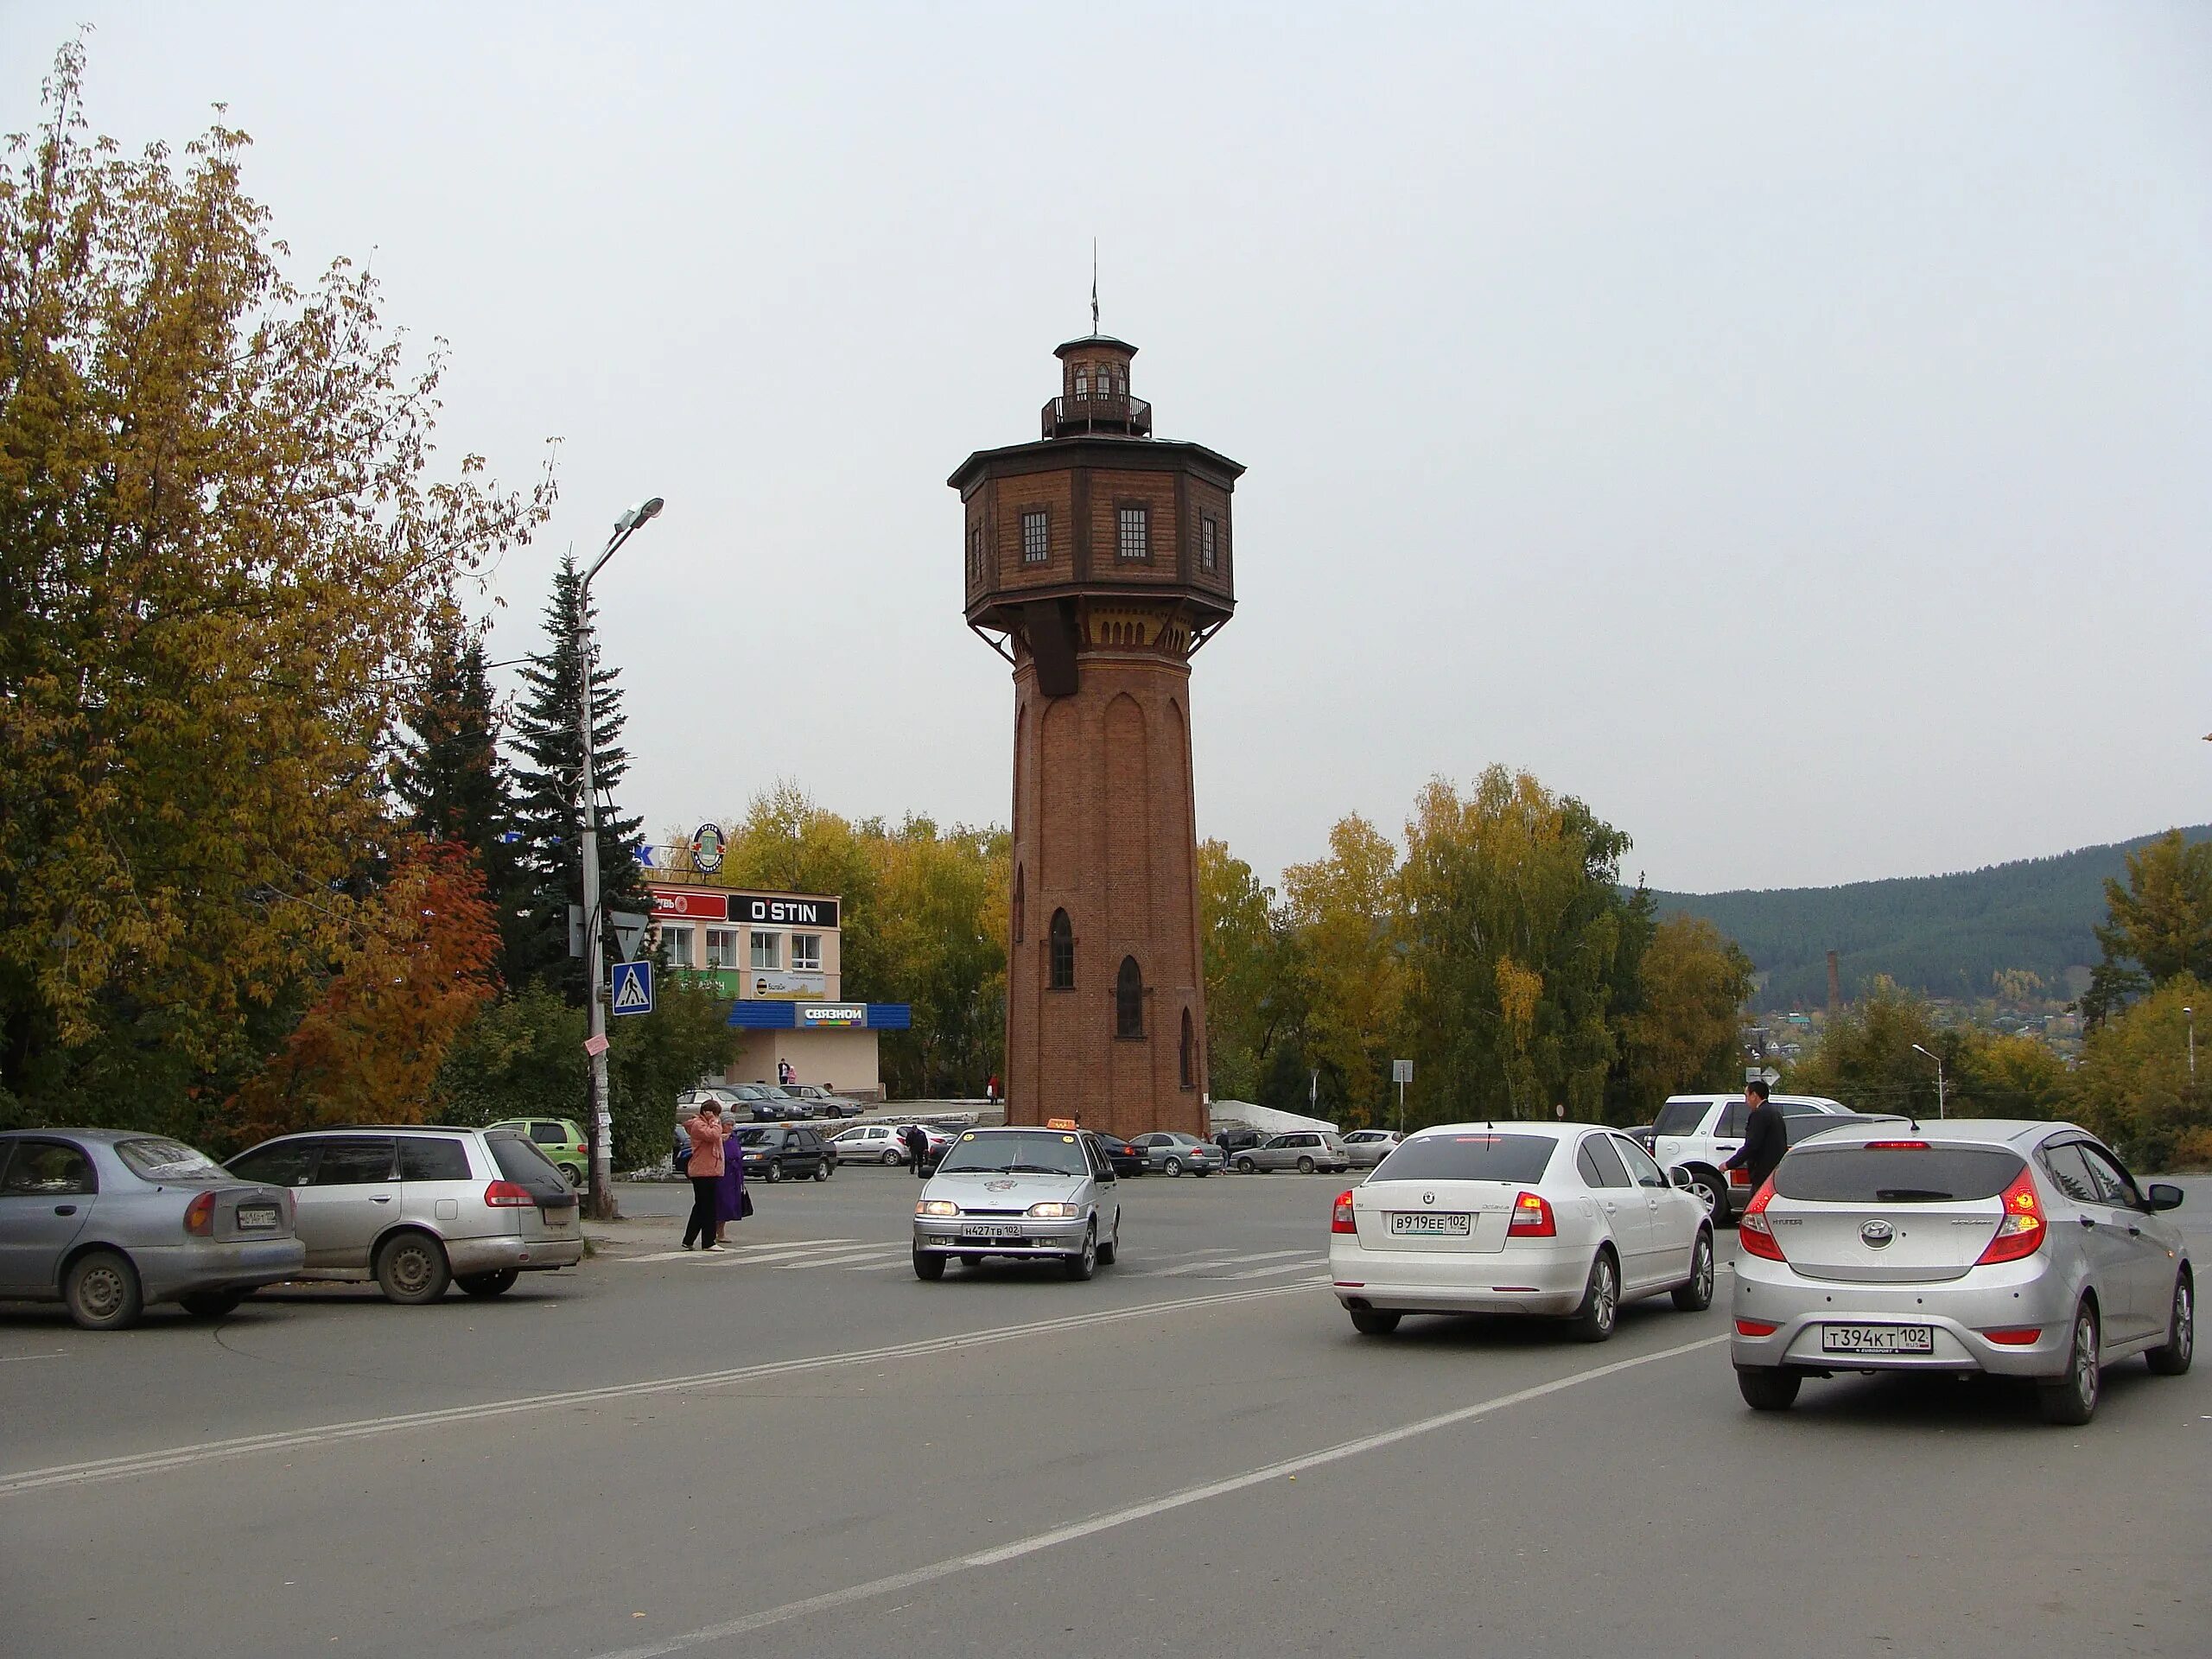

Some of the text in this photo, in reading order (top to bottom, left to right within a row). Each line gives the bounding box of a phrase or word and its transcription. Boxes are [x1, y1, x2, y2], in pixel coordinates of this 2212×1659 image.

[1395, 1215, 1466, 1230] В919ЕЕ 102
[965, 1226, 1002, 1236] Н427ТВ
[1829, 1328, 1926, 1347] Т394КТ 102
